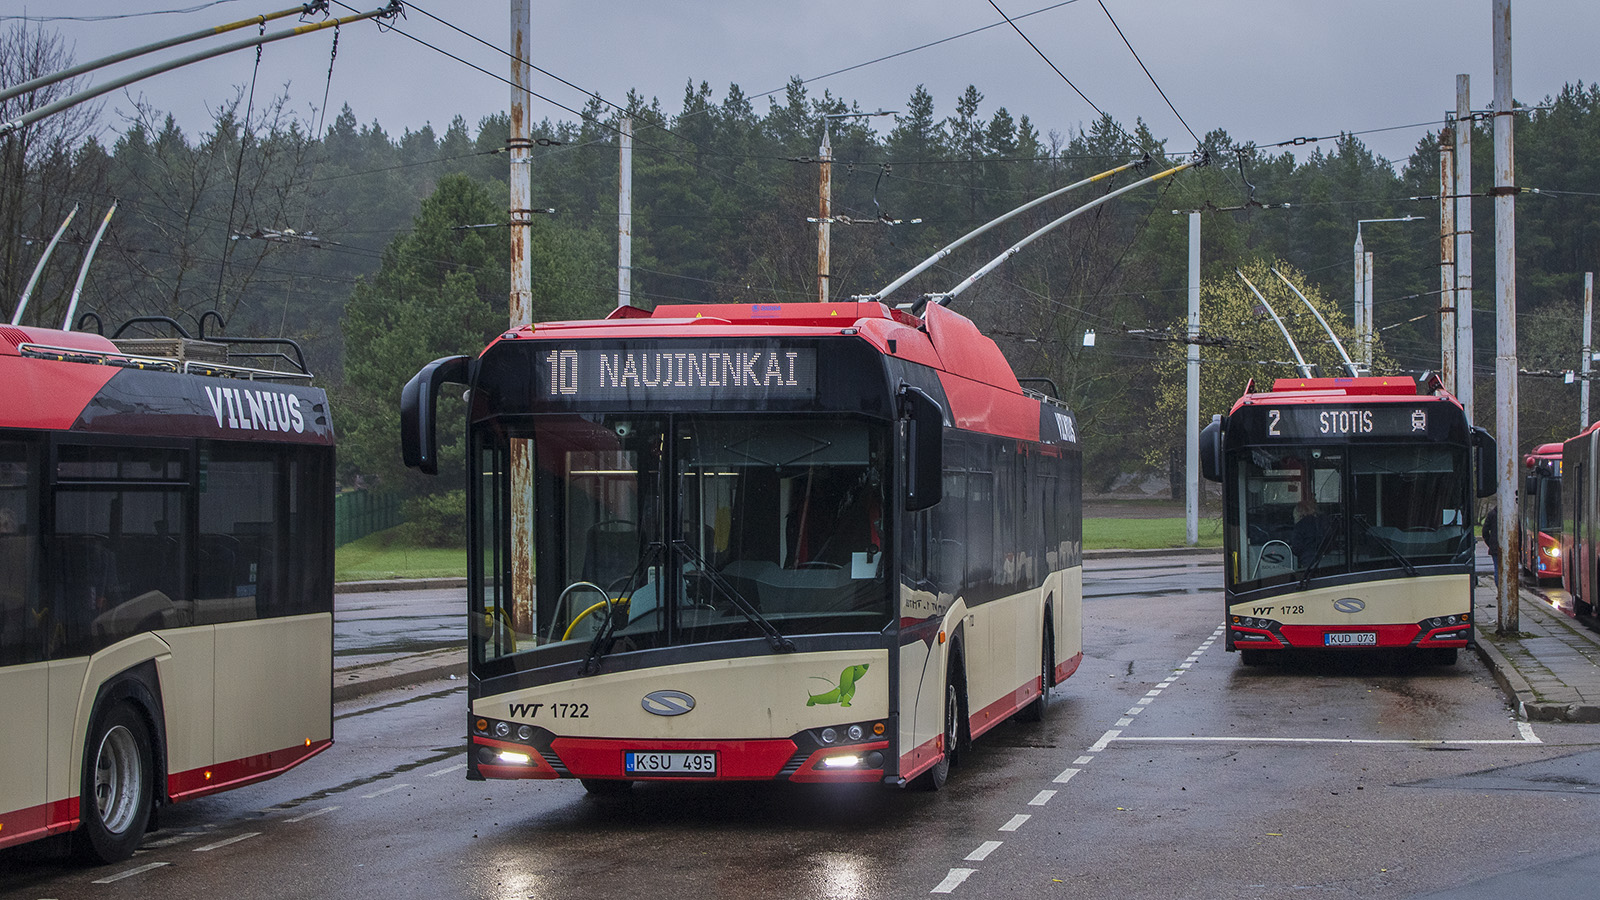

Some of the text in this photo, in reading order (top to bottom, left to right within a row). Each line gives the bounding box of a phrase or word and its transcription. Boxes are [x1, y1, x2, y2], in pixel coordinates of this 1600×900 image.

[546, 349, 798, 395] 10 NAUJININKAI
[205, 386, 305, 434] VILNIUS
[1268, 409, 1373, 436] 2 STOTIS
[1252, 605, 1305, 616] VVT 1728
[1330, 634, 1375, 643] KUD 073
[509, 703, 589, 718] VVT 1722
[636, 755, 671, 770] KSU
[683, 755, 713, 771] 495
